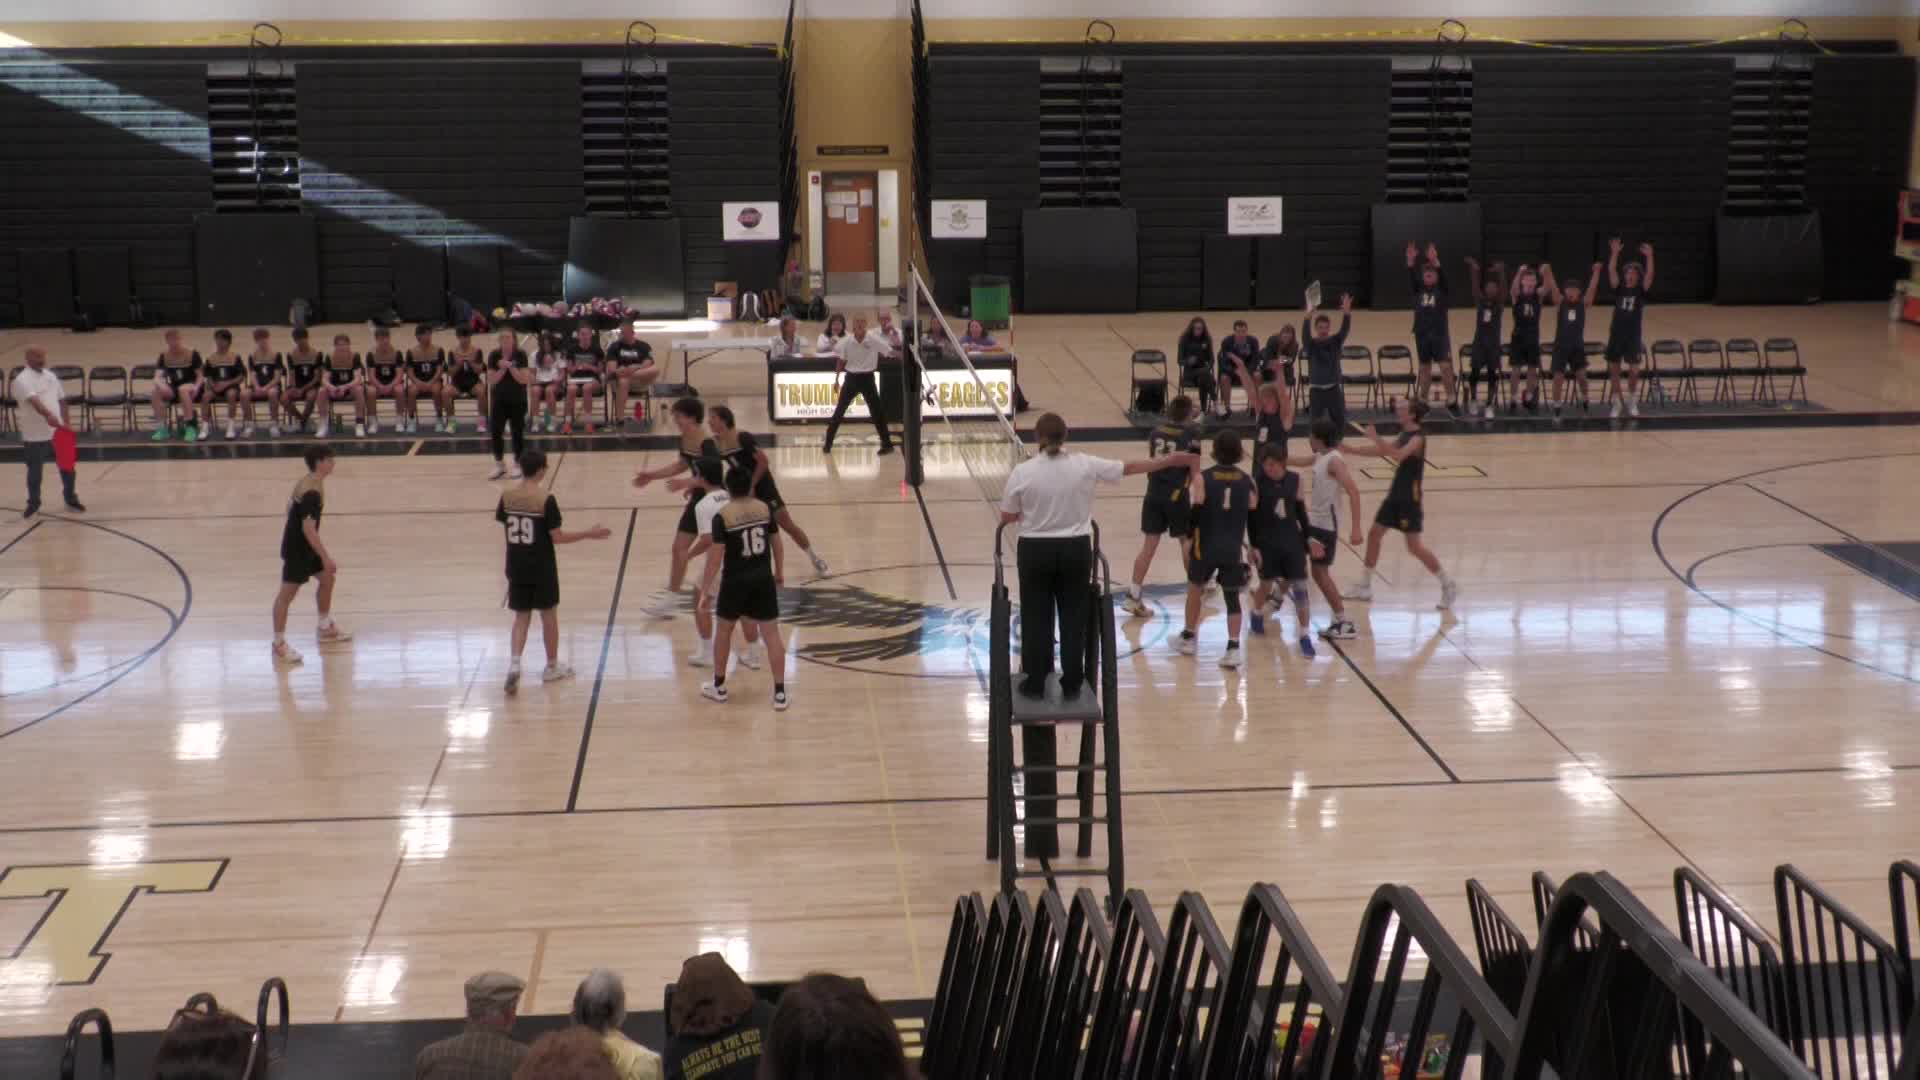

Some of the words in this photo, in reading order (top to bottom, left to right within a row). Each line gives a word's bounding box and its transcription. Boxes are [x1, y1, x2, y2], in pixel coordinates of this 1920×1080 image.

[939, 381, 1009, 408] EAGLES
[797, 407, 818, 416] HIGH
[1223, 487, 1232, 509] 1
[1274, 498, 1288, 518] 4
[507, 515, 534, 544] 29
[741, 526, 766, 557] 16
